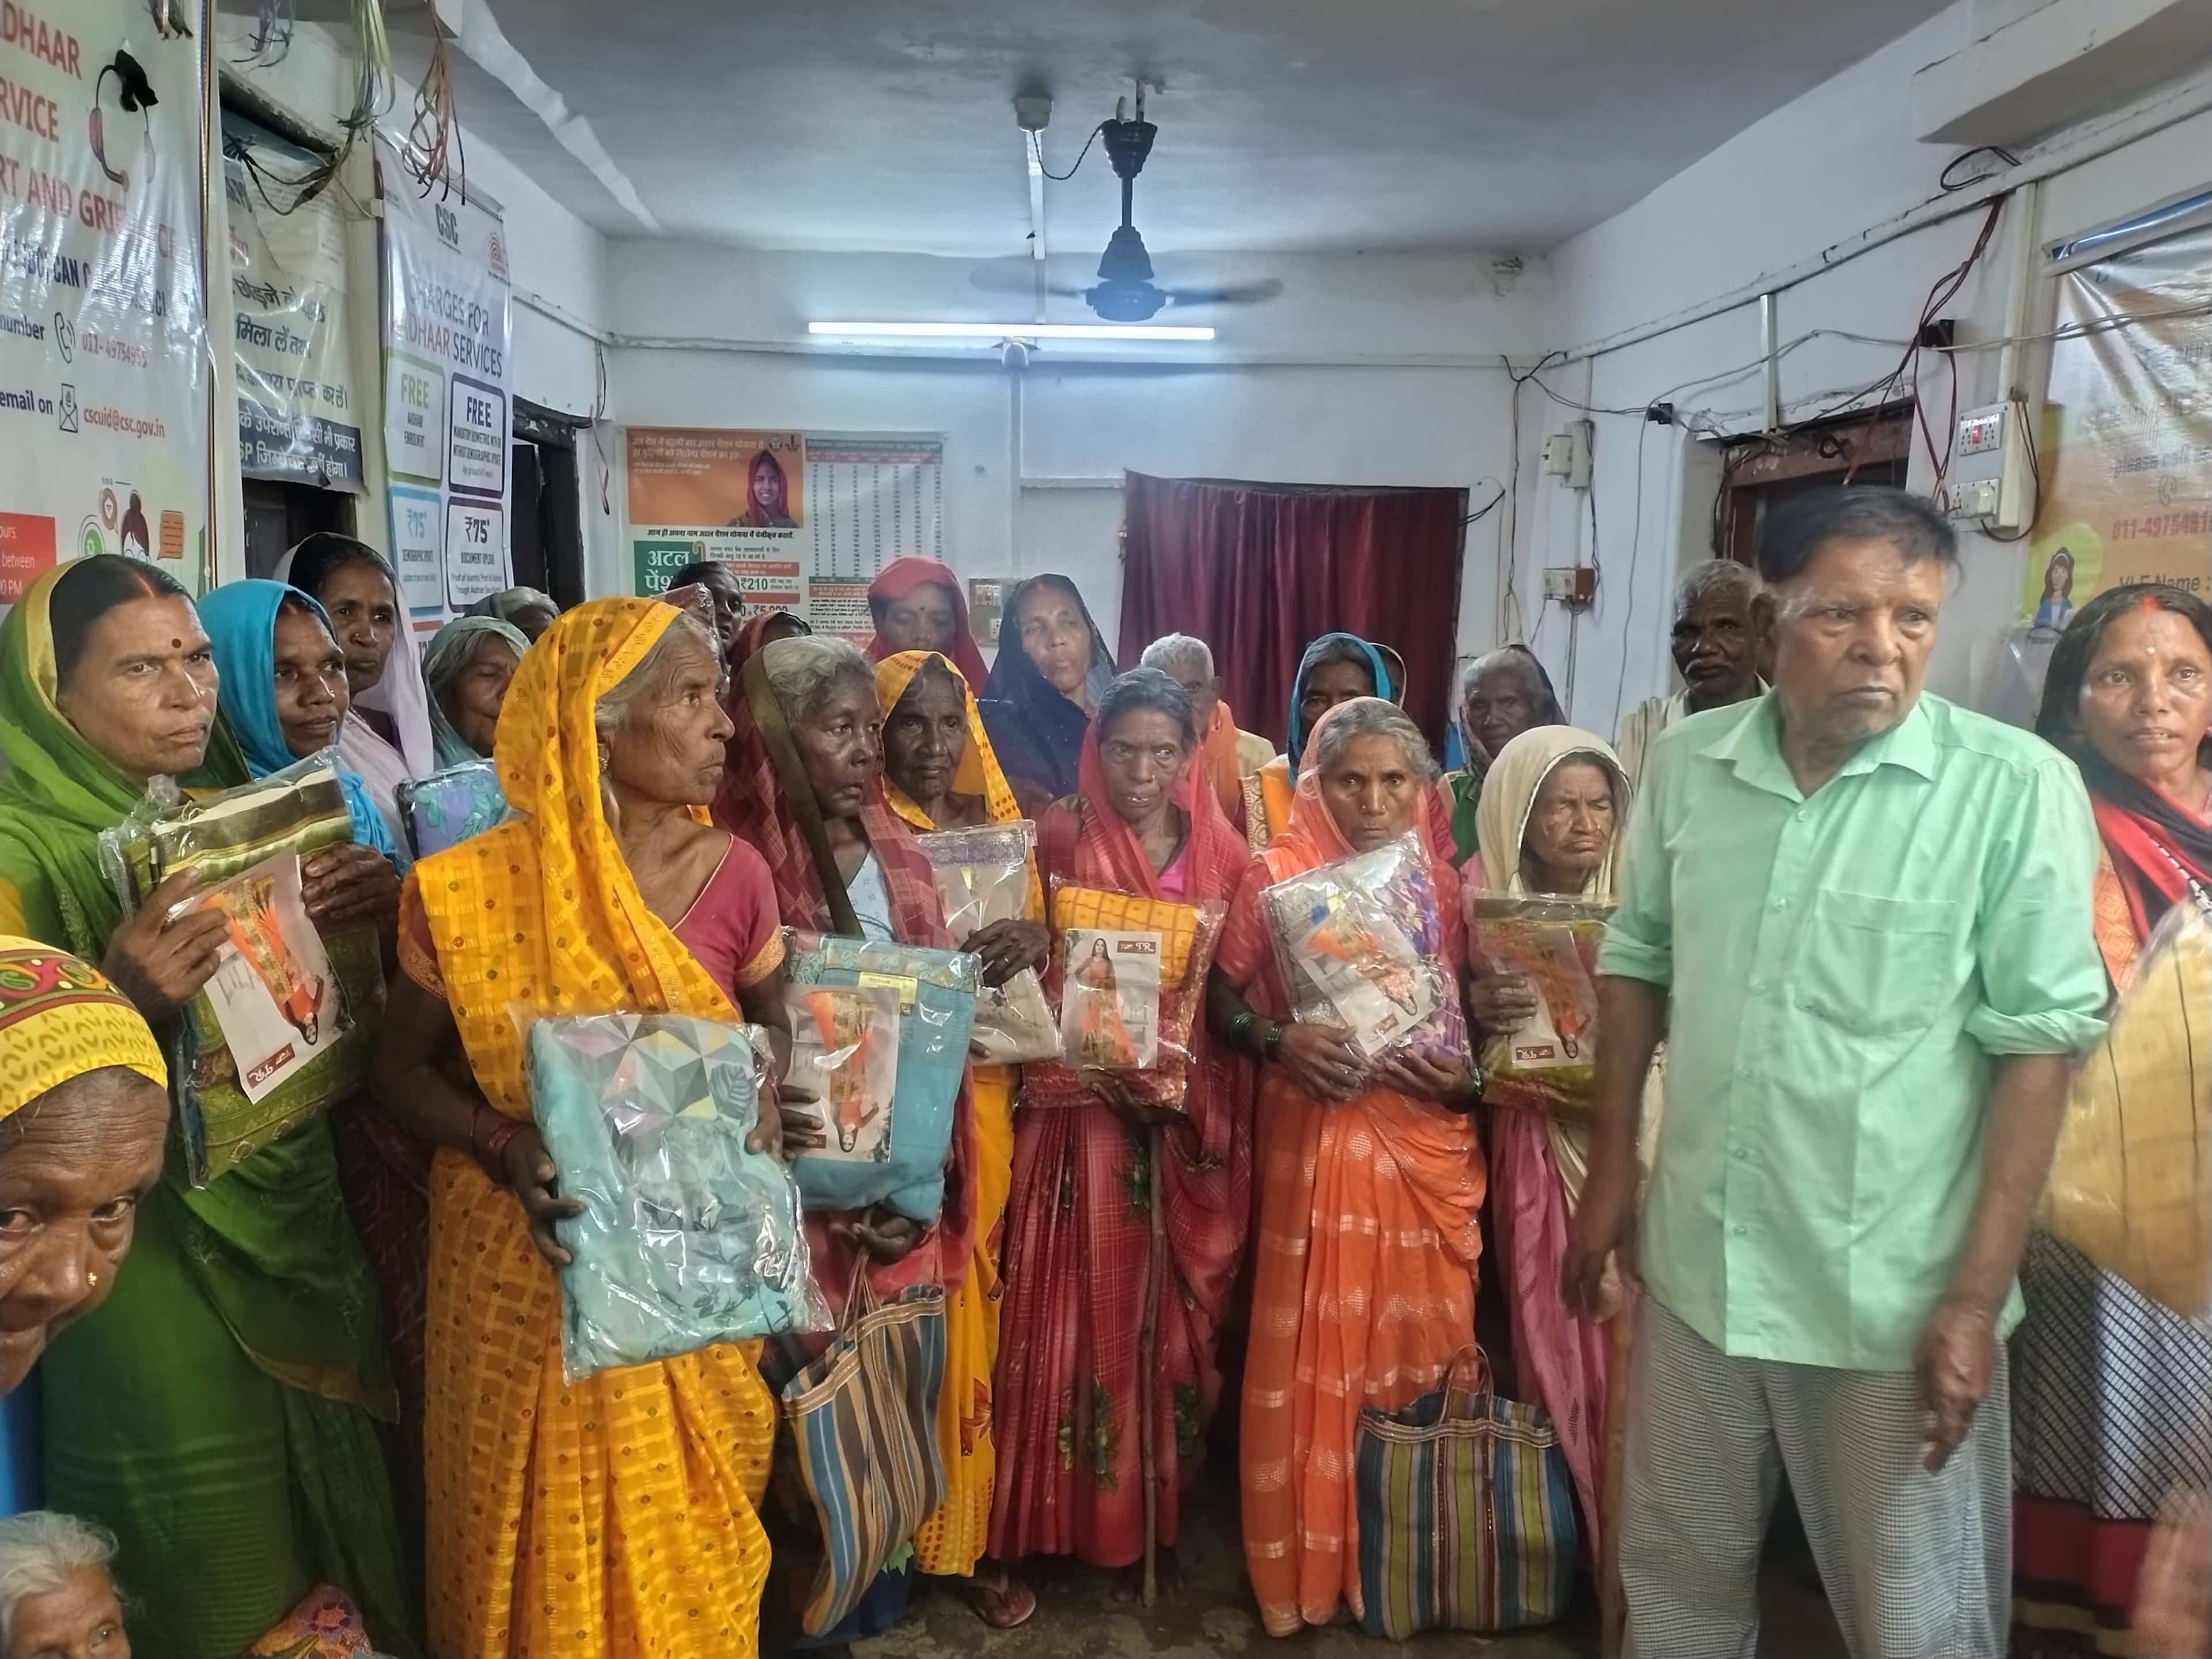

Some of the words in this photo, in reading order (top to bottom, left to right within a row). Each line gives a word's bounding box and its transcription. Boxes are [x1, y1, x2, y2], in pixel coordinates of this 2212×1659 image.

[27, 168, 72, 218] AND
[435, 203, 459, 245] CSC
[54, 253, 80, 288] CAN
[1, 315, 44, 341] number
[236, 312, 272, 347] मिला
[468, 302, 488, 336] FOR
[453, 332, 502, 378] SERVICES
[0, 389, 34, 411] email
[39, 398, 53, 415] on
[401, 373, 429, 410] FREE
[84, 407, 165, 438] cscuid@csc.gov.in
[467, 395, 491, 428] FREE
[2, 550, 35, 569] between
[647, 550, 691, 567] अटल
[9, 579, 22, 596] PM
[645, 569, 673, 592] पेंश
[740, 577, 768, 590] ₹210
